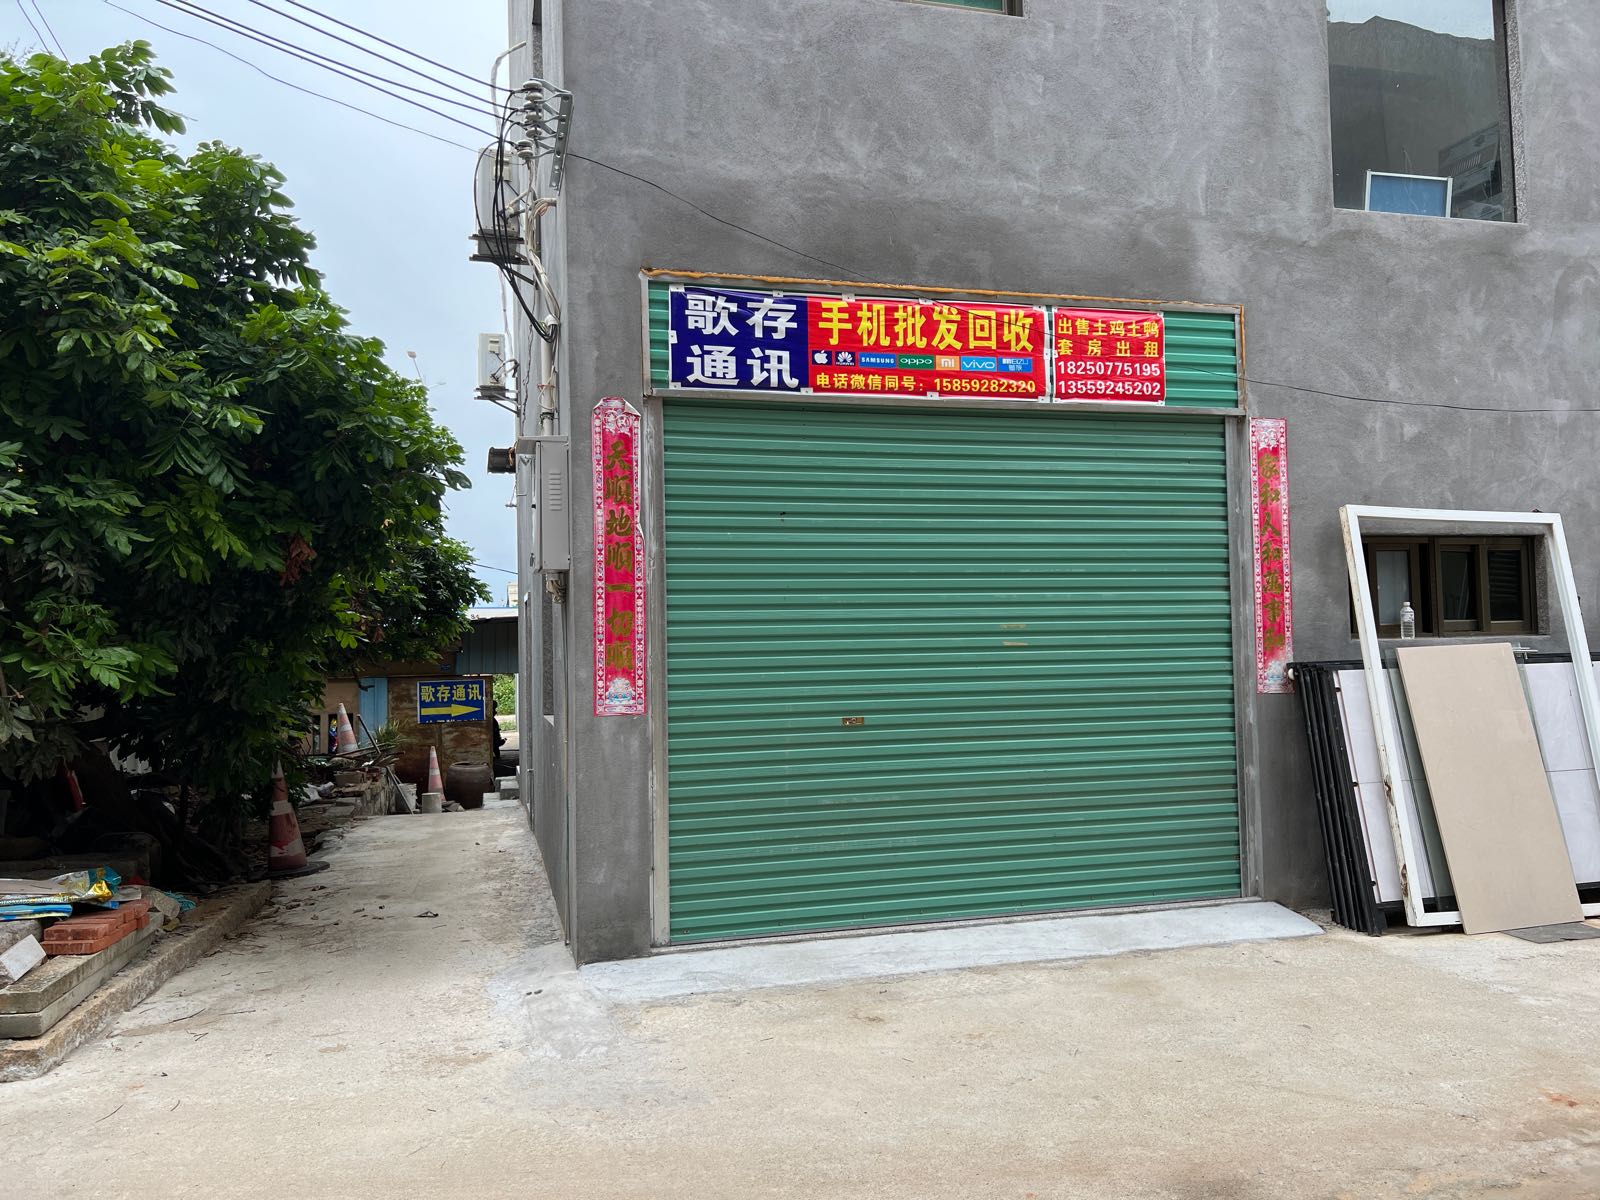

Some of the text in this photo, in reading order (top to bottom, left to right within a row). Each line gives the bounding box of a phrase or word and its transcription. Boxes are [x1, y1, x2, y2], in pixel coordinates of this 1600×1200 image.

[685, 294, 798, 339] 歌存
[818, 301, 1034, 352] 手机批发回收
[1058, 317, 1159, 338] 出售土鸡土鸭
[1058, 339, 1159, 357] 套房出租
[686, 344, 799, 388] 通讯
[861, 356, 895, 364] SAMSUNG
[962, 360, 996, 369] vivo
[1058, 361, 1161, 377] 18250775195
[934, 378, 1036, 393] 15859282320
[1058, 380, 1161, 396] 13559245202
[420, 684, 482, 702] 歌存通讯
